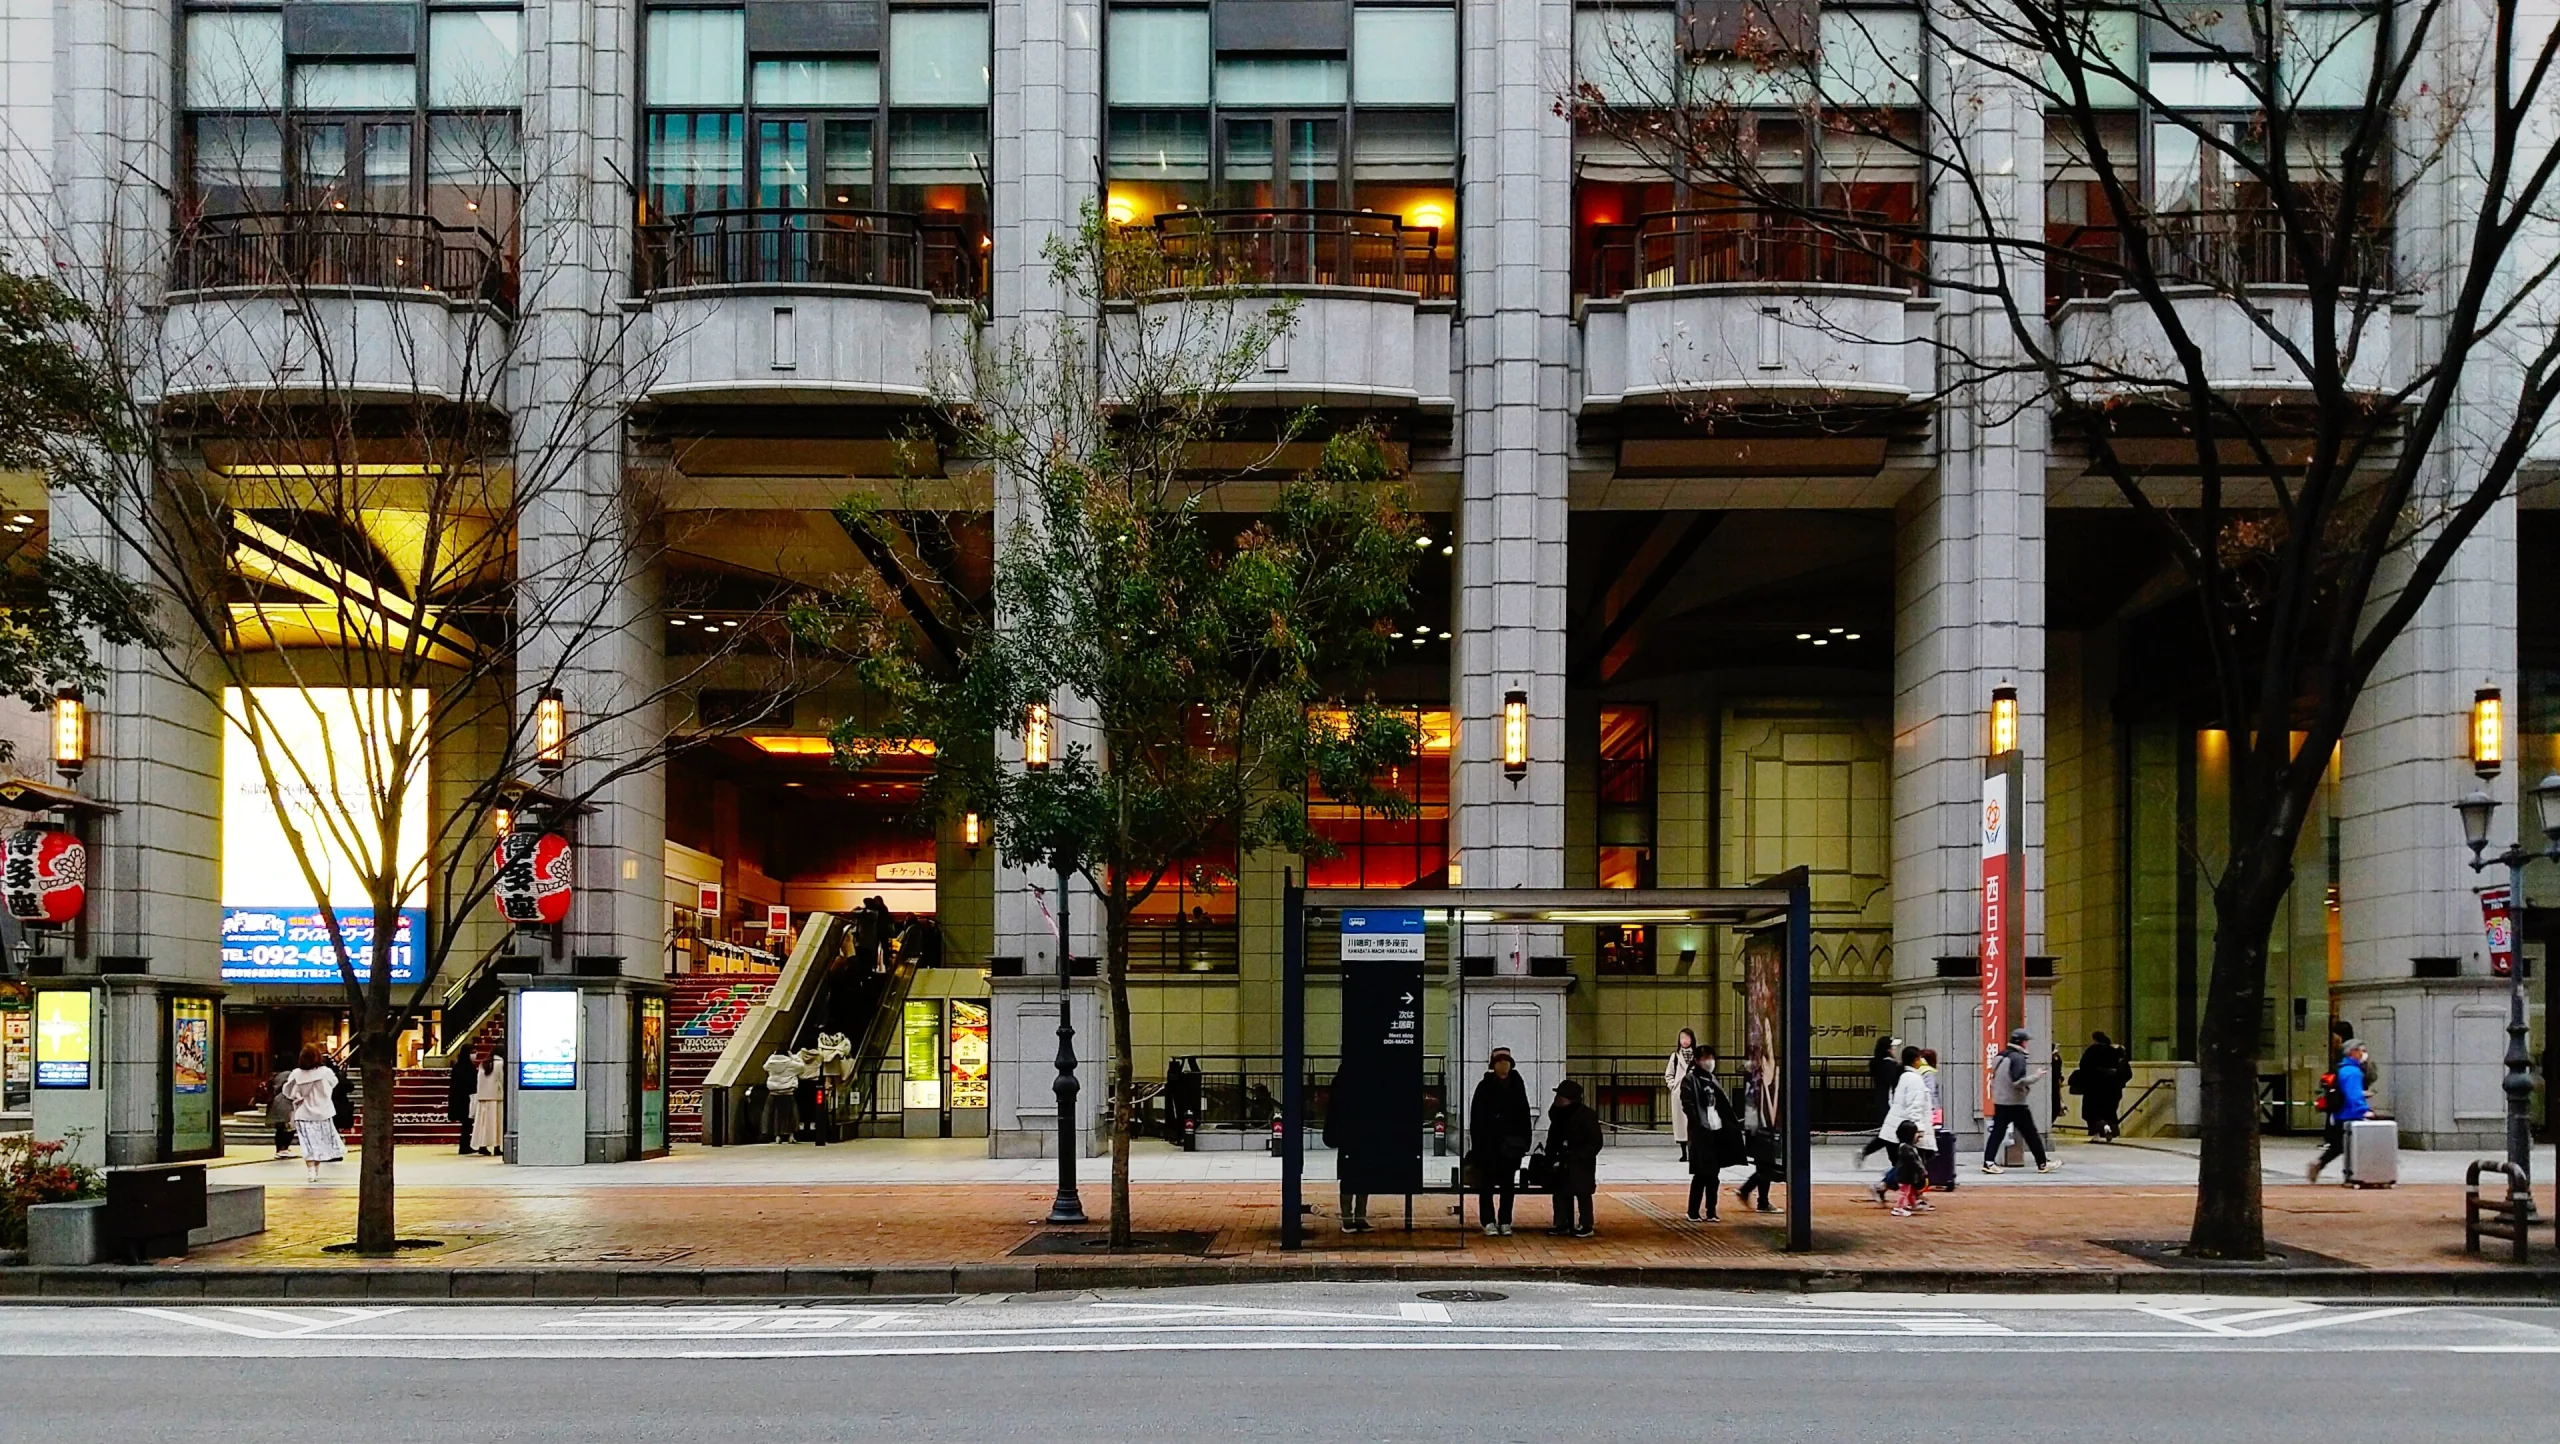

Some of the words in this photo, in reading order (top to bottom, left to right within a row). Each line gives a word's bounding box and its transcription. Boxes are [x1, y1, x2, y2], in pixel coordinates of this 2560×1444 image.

[6, 830, 42, 917] 博多座
[503, 832, 540, 919] 博多座
[1390, 1020, 1415, 1030] 土居町
[1398, 1011, 1415, 1019] 次は
